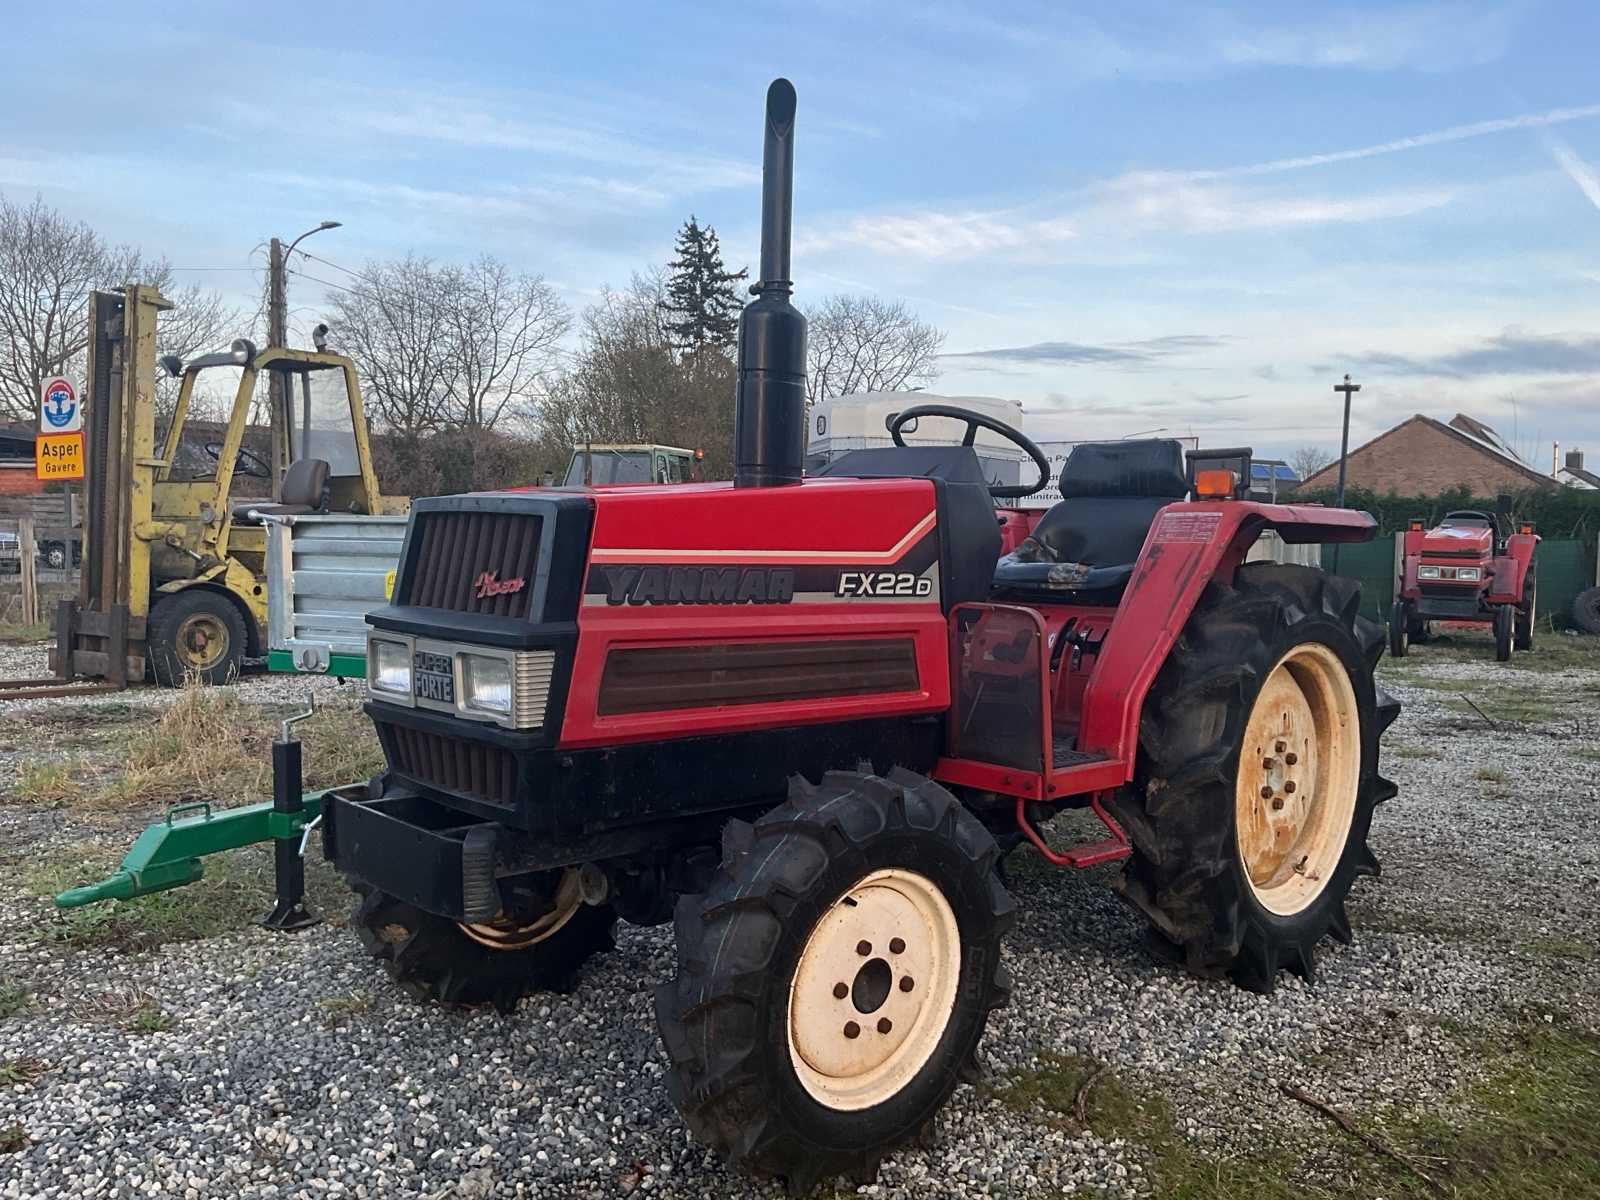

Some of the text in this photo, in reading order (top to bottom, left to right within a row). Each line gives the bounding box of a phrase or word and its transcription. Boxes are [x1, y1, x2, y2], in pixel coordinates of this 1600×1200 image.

[42, 442, 79, 460] Asper
[45, 462, 76, 473] Gavere
[601, 565, 793, 604] YANMAR
[837, 572, 932, 595] FX22D
[415, 652, 449, 672] SUPER
[415, 672, 452, 702] FORTE
